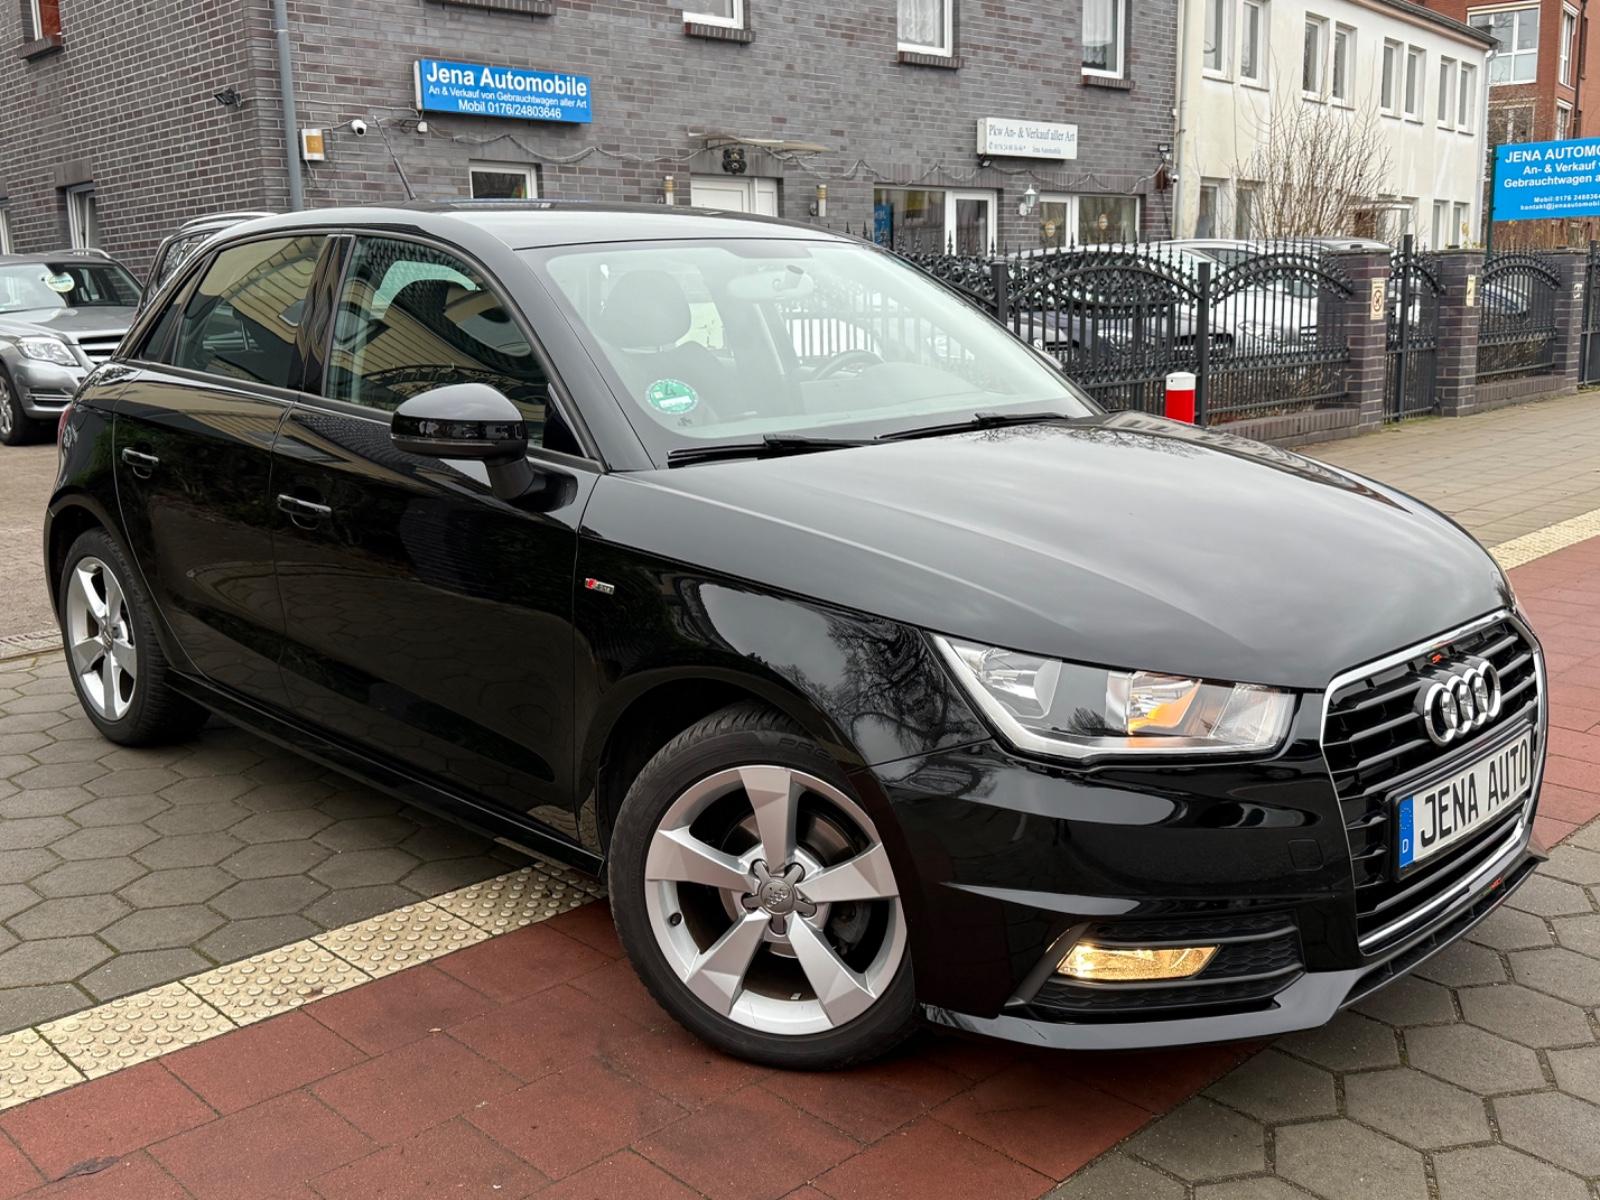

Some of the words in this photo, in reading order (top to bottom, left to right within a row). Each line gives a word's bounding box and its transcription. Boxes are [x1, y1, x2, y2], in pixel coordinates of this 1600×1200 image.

[426, 62, 474, 86] Jena
[480, 68, 587, 96] Automobile
[429, 86, 440, 94] An
[442, 87, 448, 96] &
[450, 87, 480, 99] Verkauf
[481, 92, 495, 100] von
[496, 92, 559, 107] Gebrauchtwagen
[560, 97, 575, 107] aller
[576, 100, 587, 108] Art
[459, 100, 485, 112] Mobil
[488, 102, 561, 118] 0176/24803646
[1505, 150, 1541, 163] JENA
[1523, 166, 1542, 175] An-
[1544, 163, 1552, 173] &
[1555, 160, 1596, 173] Verkauf
[1504, 175, 1592, 187] Gebrauchtwagen
[1420, 772, 1479, 847] JENA
[1487, 738, 1528, 812] AUTO
[1402, 838, 1409, 853] D
